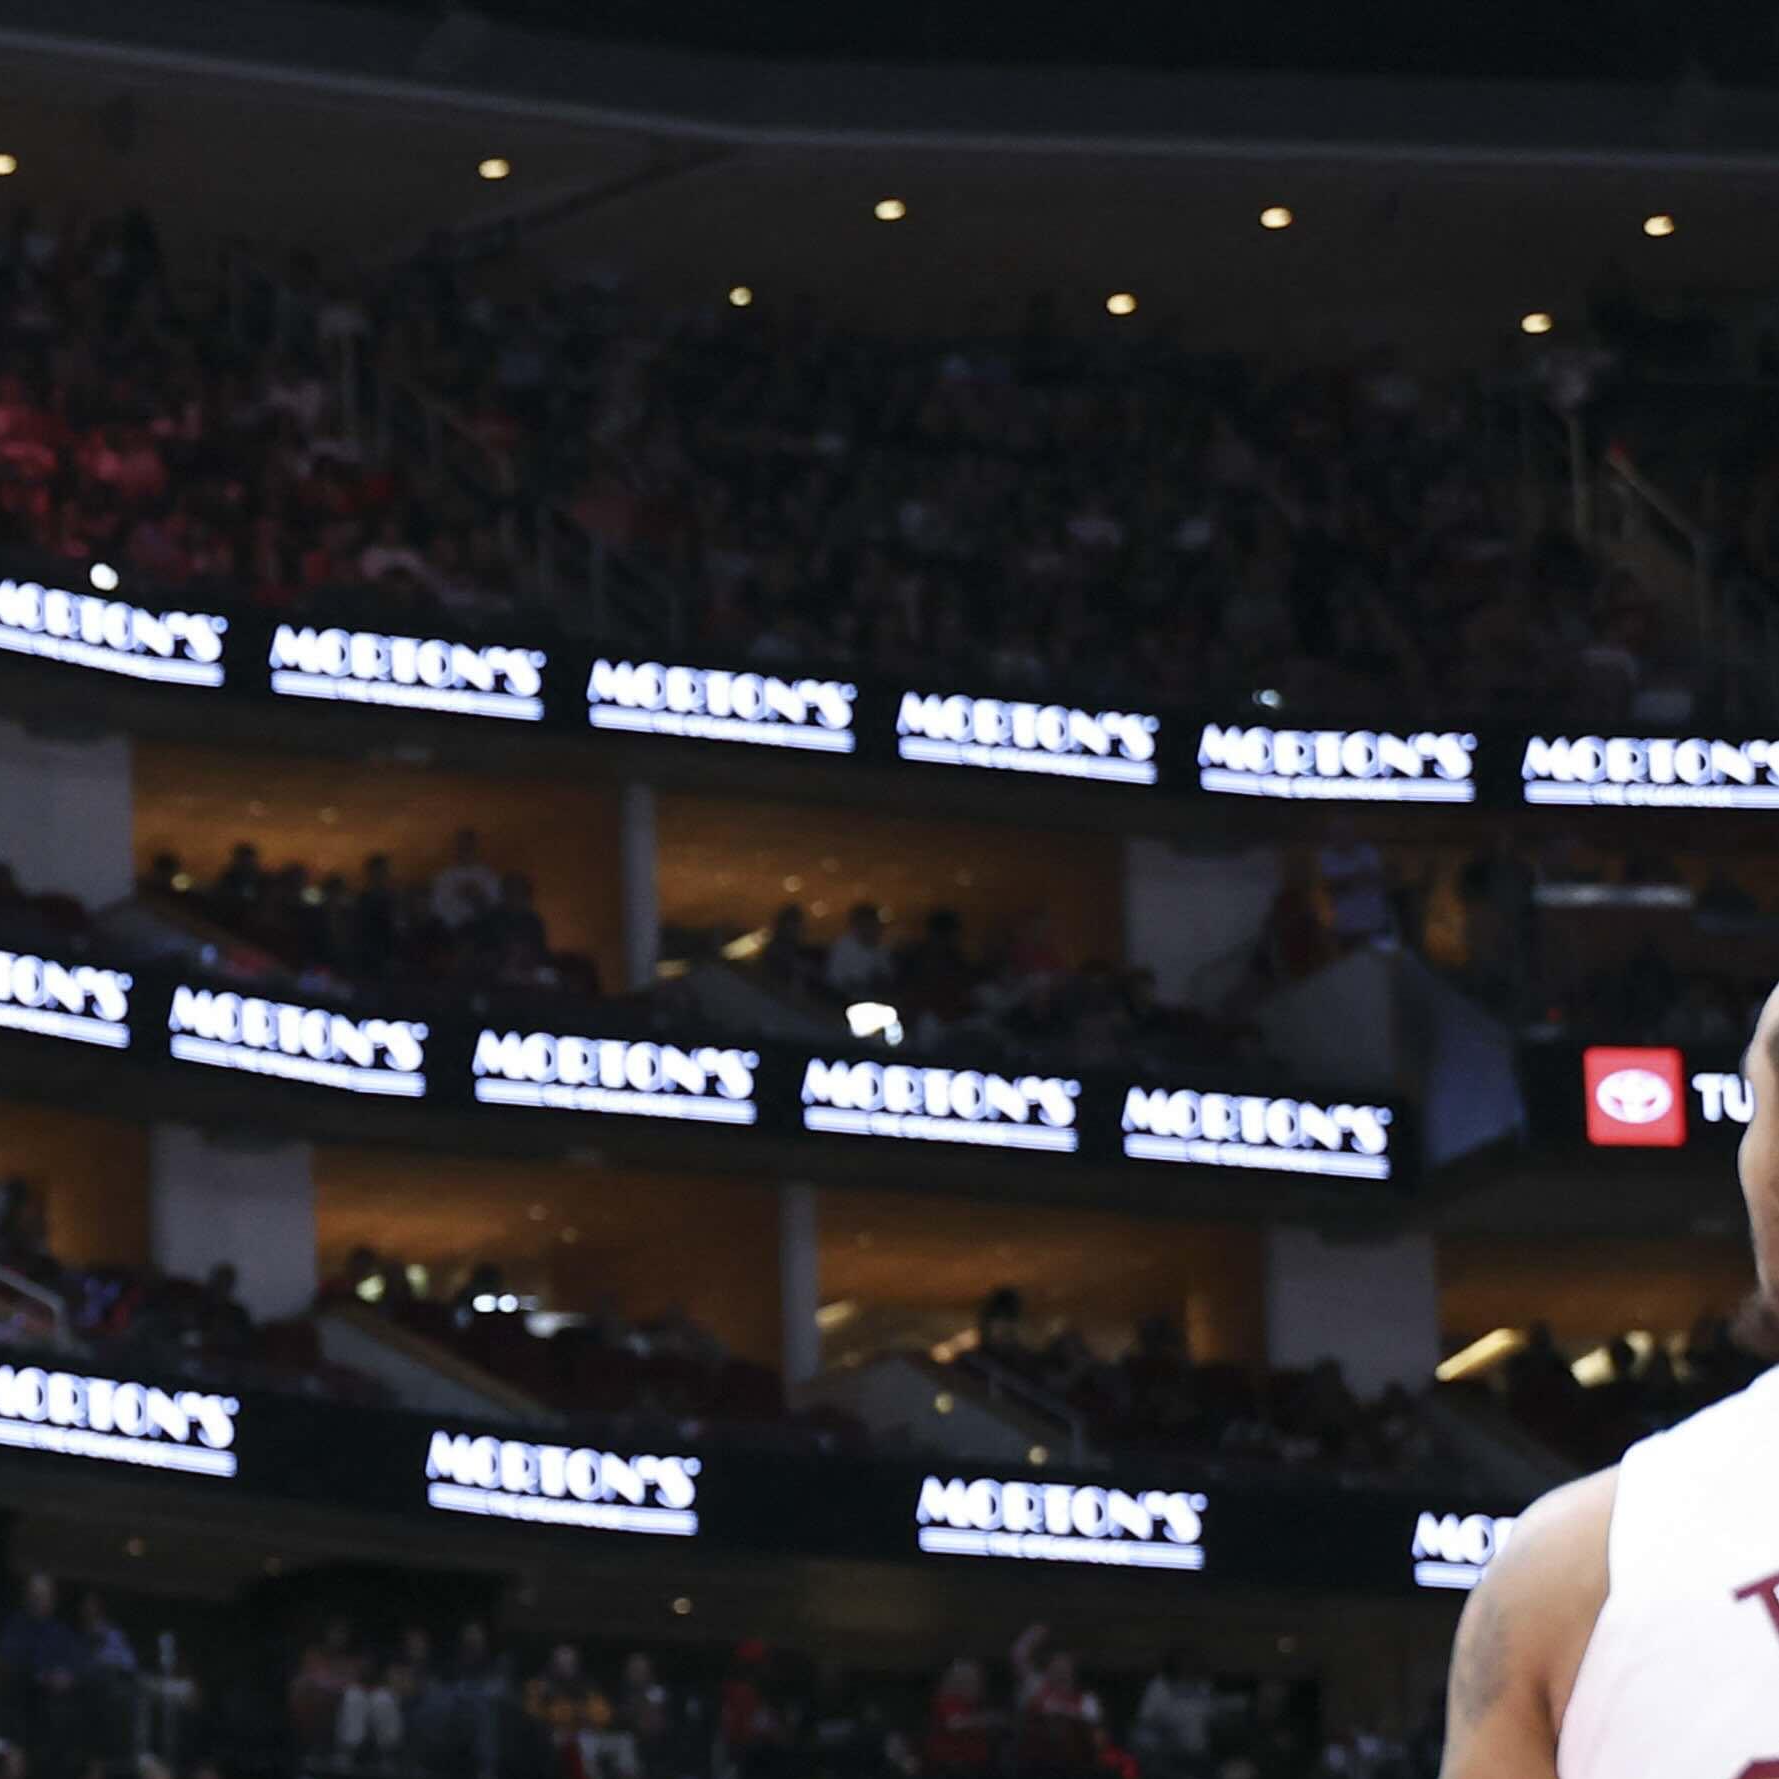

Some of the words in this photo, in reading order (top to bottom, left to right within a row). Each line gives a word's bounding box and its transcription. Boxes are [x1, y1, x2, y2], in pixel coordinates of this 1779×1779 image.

[268, 624, 547, 698] MORTON'S
[586, 658, 858, 731] MORTON'S
[895, 691, 1160, 763] MORTON'S
[1197, 723, 1478, 781] MORTON'S
[167, 985, 429, 1073] MORTON'S
[471, 1029, 760, 1101] MORTON'S
[800, 1058, 1081, 1129] MORTON'S
[1120, 1086, 1392, 1156] MORTON'S
[425, 1430, 702, 1510] MORTON'S
[915, 1475, 1208, 1545] MORTON'S
